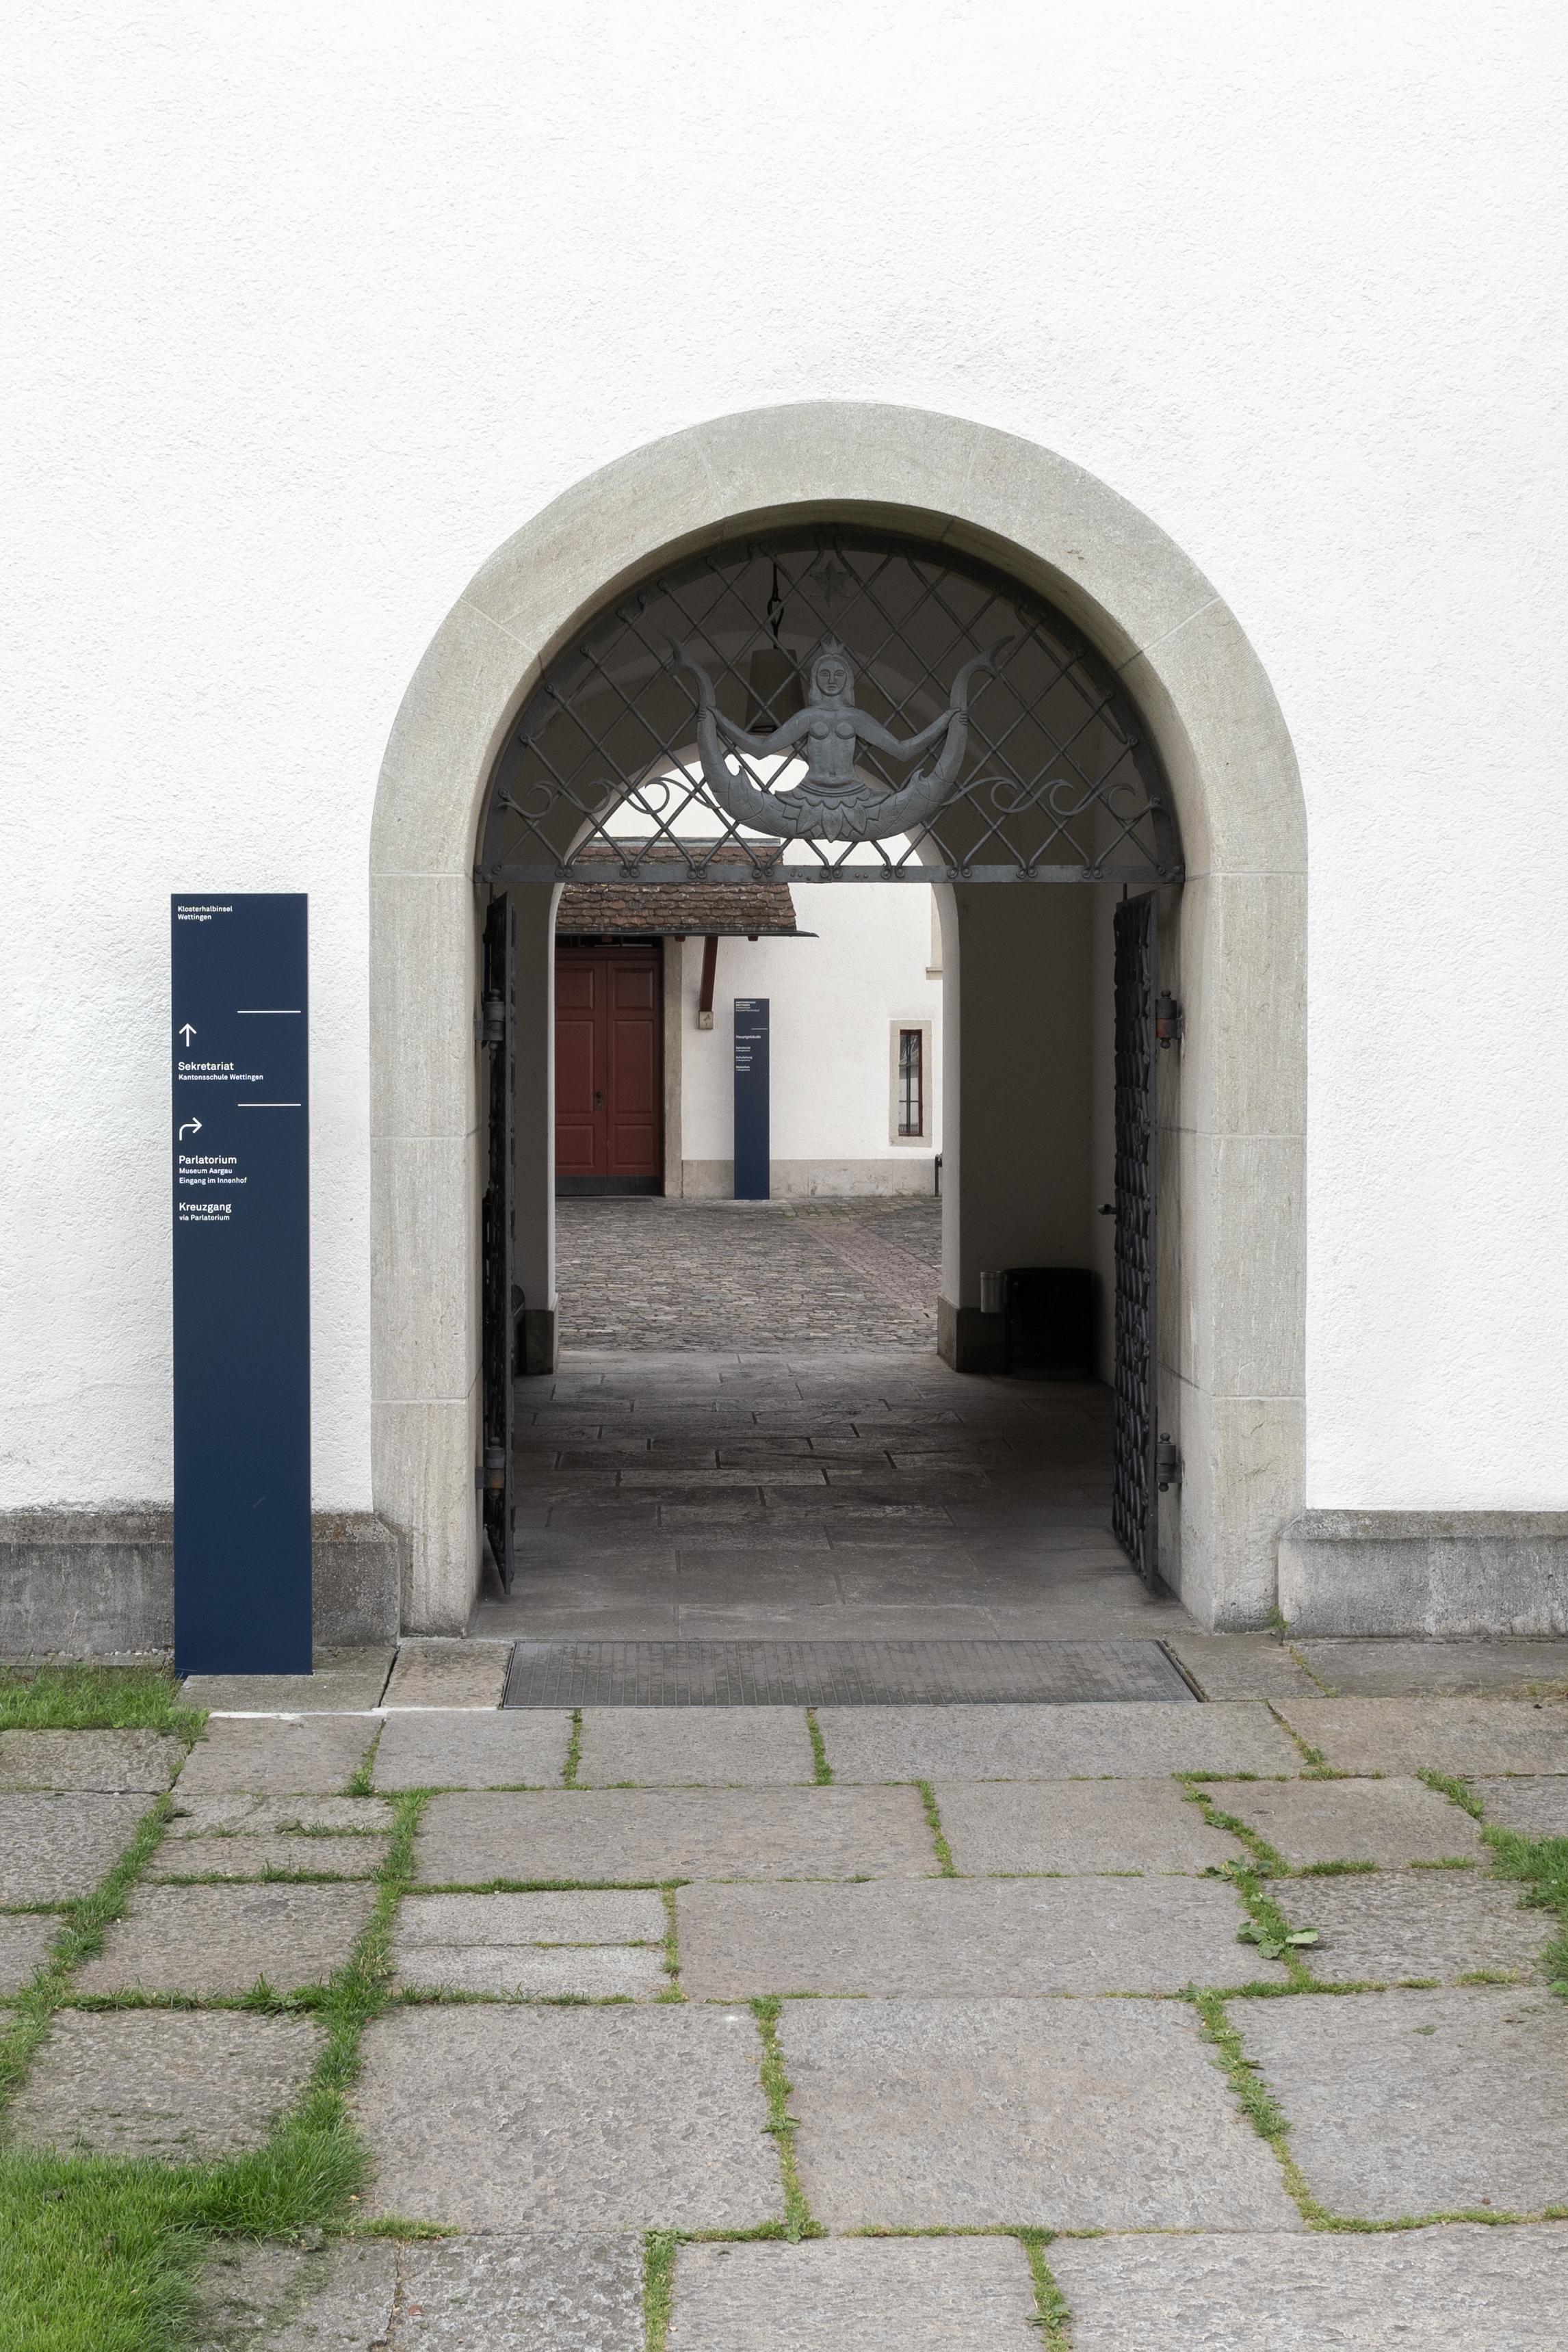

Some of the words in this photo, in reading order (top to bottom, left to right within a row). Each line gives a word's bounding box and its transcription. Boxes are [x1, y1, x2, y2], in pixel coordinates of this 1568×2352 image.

[178, 1061, 235, 1071] Sekretariat
[229, 1073, 264, 1082] Wettingen
[179, 1155, 237, 1164] Parlatorium
[209, 1167, 233, 1176] Aargau
[179, 1177, 207, 1186] Eingang
[179, 1202, 232, 1214] Kreuzgang
